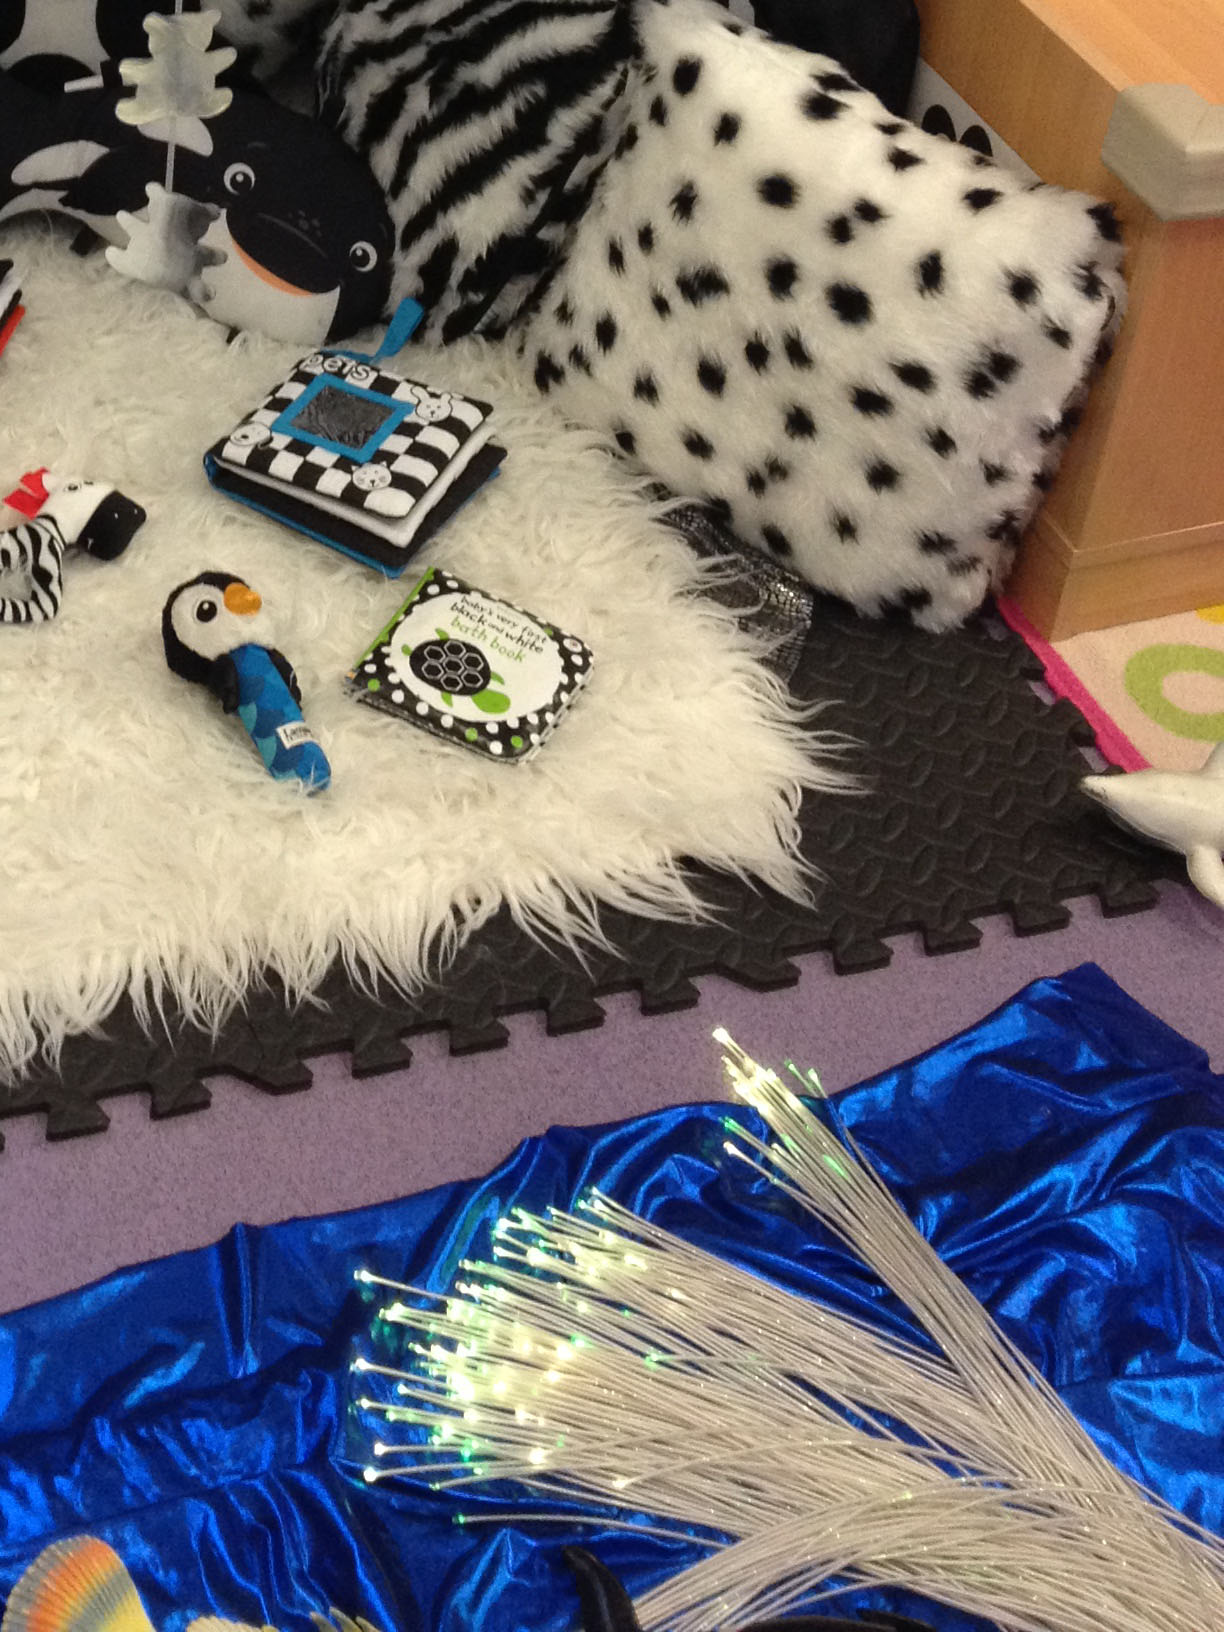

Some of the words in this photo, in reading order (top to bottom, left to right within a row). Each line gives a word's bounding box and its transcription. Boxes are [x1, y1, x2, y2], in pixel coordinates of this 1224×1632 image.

[298, 353, 372, 381] pets
[450, 601, 487, 626] black
[505, 631, 544, 653] white
[451, 615, 487, 641] bath
[490, 636, 526, 663] book
